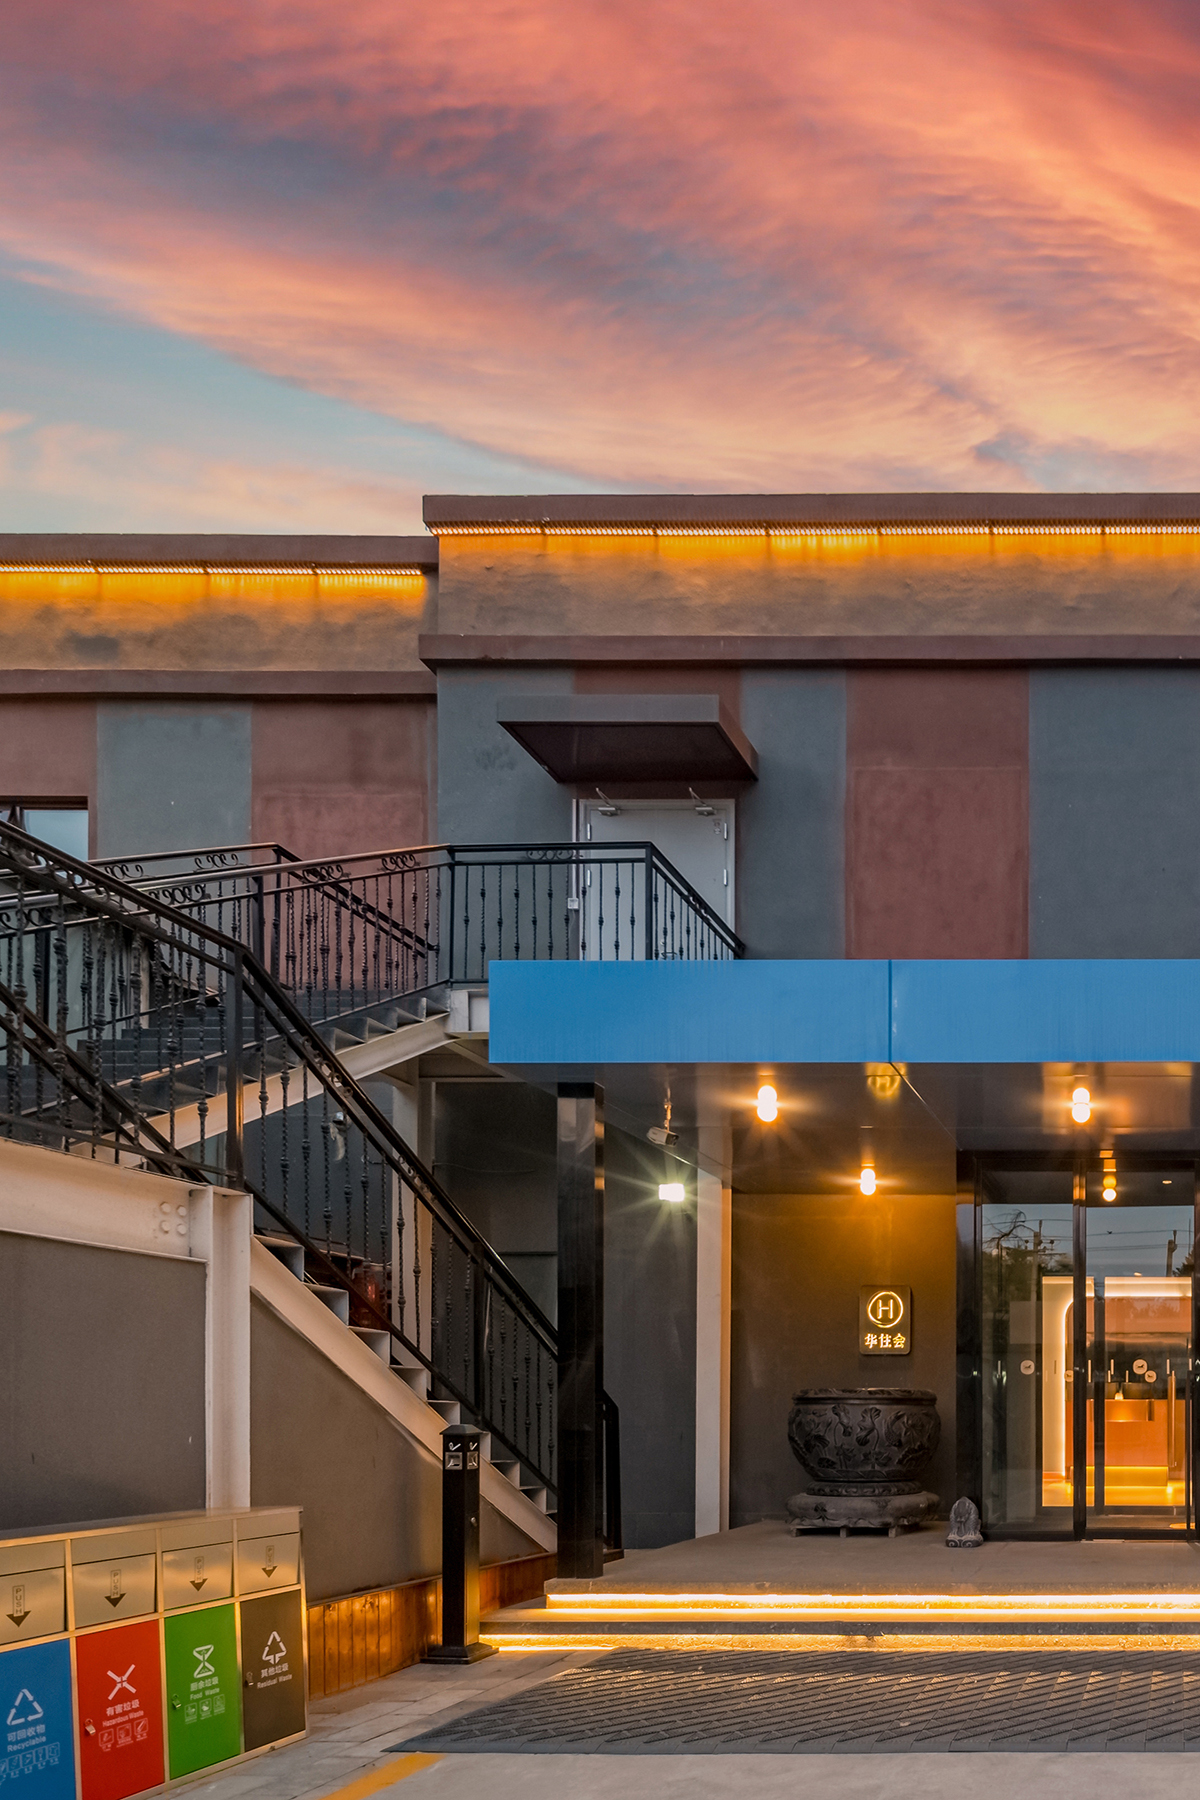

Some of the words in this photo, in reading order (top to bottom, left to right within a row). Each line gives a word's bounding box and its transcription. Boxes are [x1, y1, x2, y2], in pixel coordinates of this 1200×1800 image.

[877, 1299, 894, 1319] H
[864, 1332, 906, 1349] 华住会
[260, 1662, 289, 1678] 其他垃圾
[257, 1677, 278, 1689] Residual
[278, 1674, 293, 1683] Waste
[190, 1691, 203, 1700] Food
[204, 1687, 220, 1696] Waste
[106, 1699, 140, 1717] 有害垃圾
[102, 1715, 129, 1727] Hazardous
[128, 1710, 144, 1719] Waste
[7, 1724, 46, 1742] 可回收物
[7, 1735, 47, 1752] Recyclable
